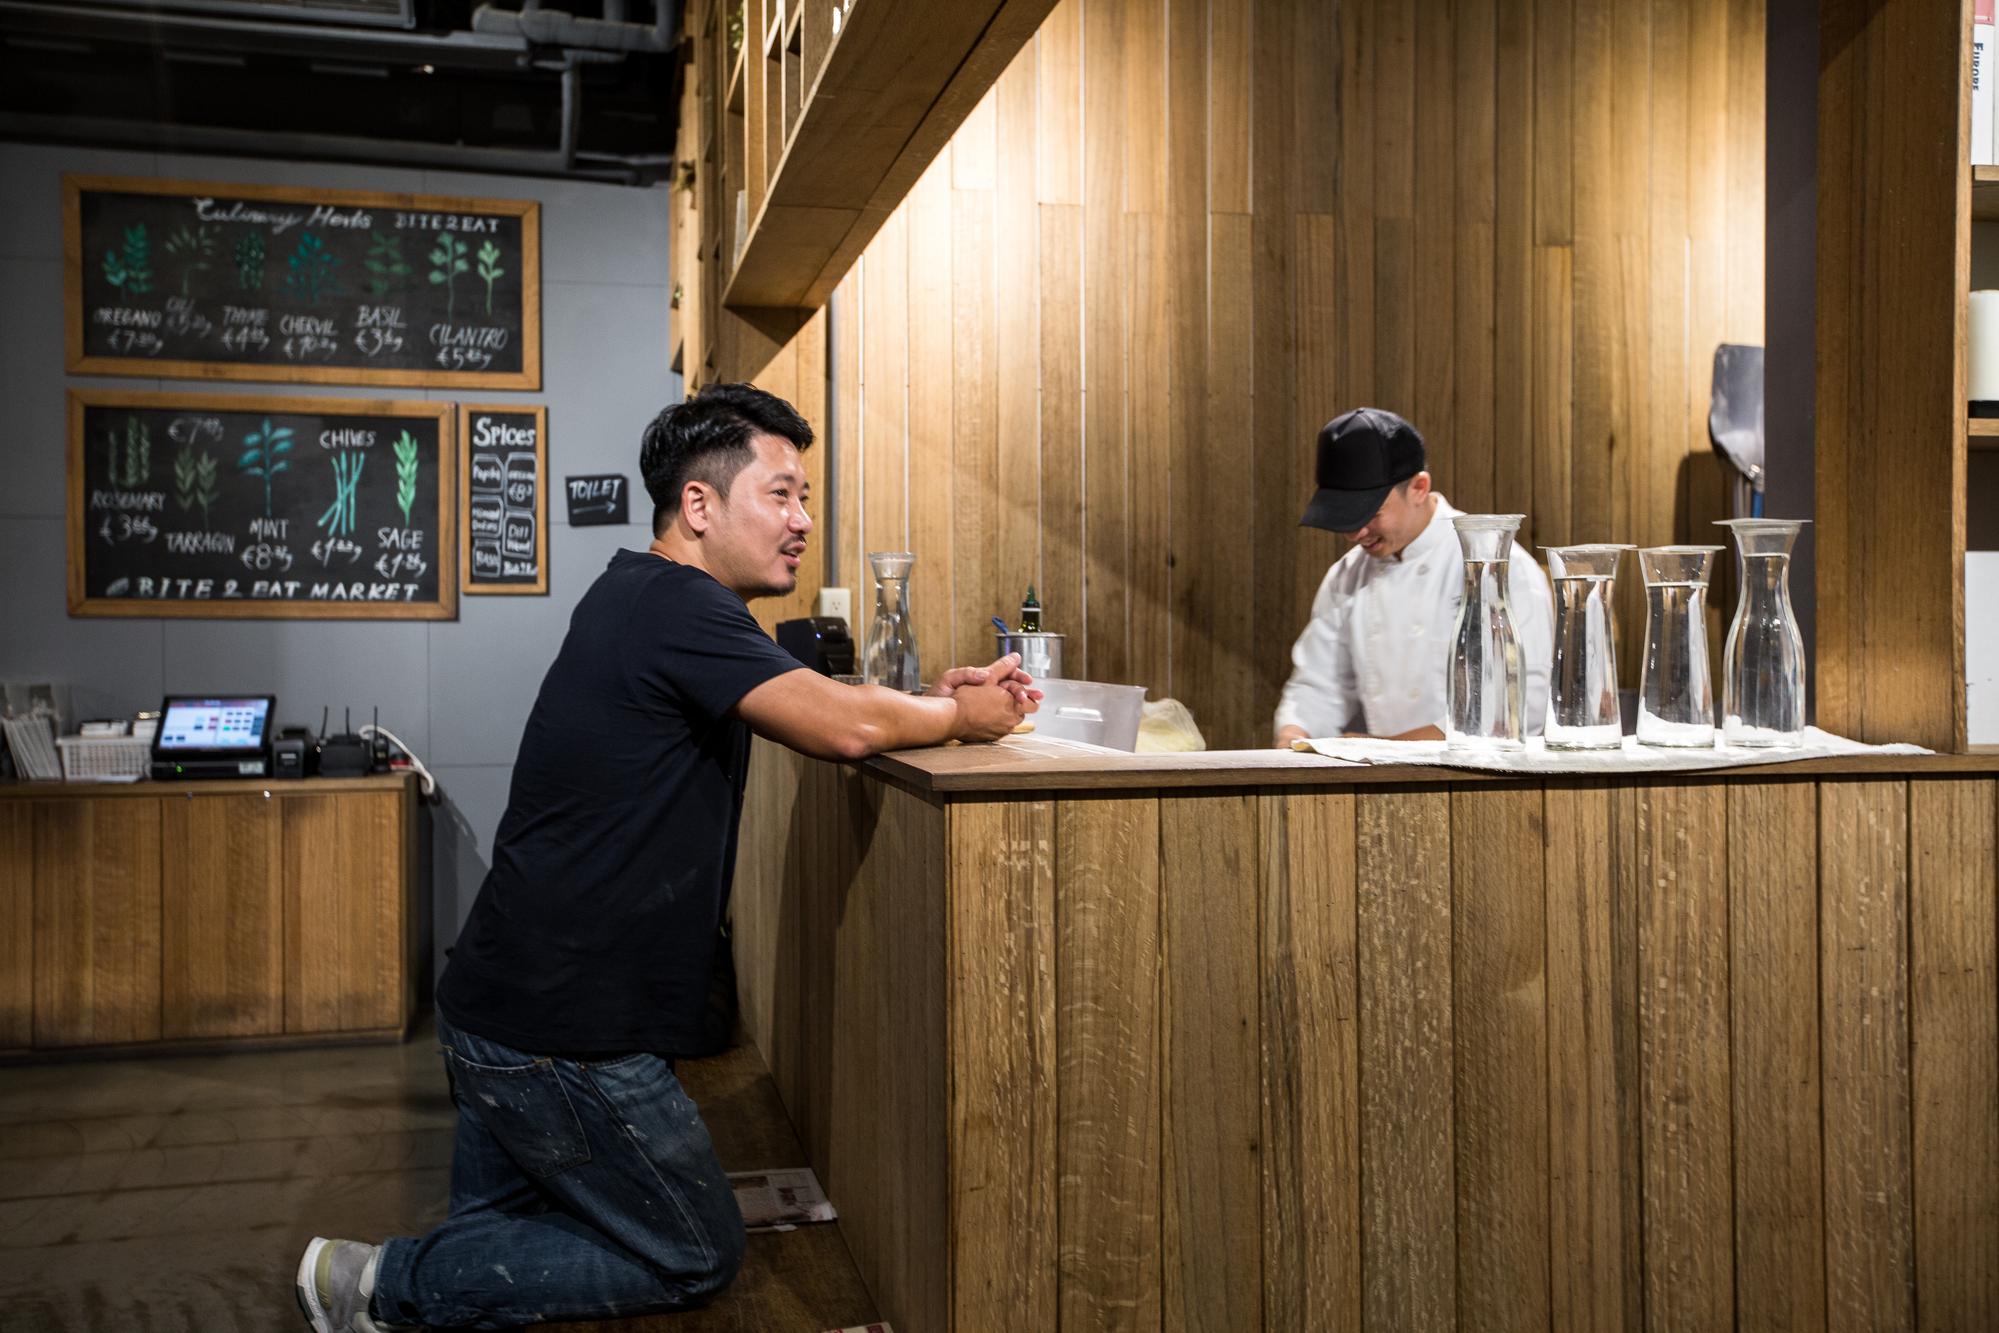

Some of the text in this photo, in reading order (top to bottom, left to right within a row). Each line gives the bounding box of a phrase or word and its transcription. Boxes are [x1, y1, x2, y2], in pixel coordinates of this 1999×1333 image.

[355, 304, 407, 328] BASIL
[429, 323, 509, 351] CILANTRO
[319, 428, 377, 449] CHIVES
[473, 417, 536, 447] Spices
[569, 479, 622, 501] TOILET
[249, 518, 288, 542] MINT
[377, 527, 423, 550] SAGE
[136, 577, 214, 597] BITE
[252, 580, 301, 598] EAT
[310, 582, 419, 602] MARKET
